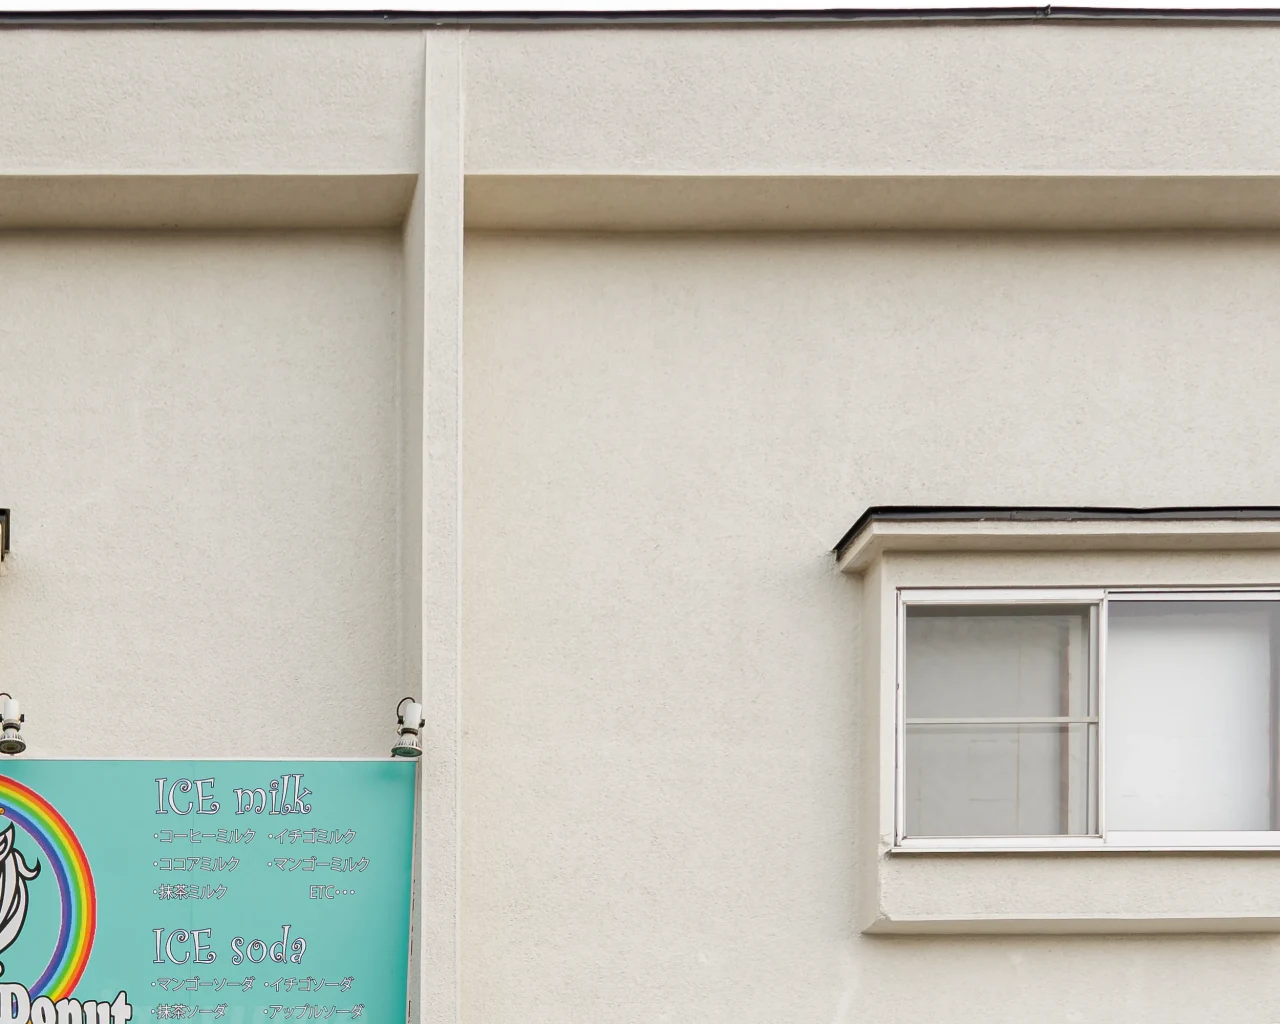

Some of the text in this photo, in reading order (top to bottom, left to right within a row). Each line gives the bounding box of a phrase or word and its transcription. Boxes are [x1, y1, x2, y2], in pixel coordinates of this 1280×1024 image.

[155, 774, 312, 815] ICE milk
[152, 925, 307, 965] ICE soda
